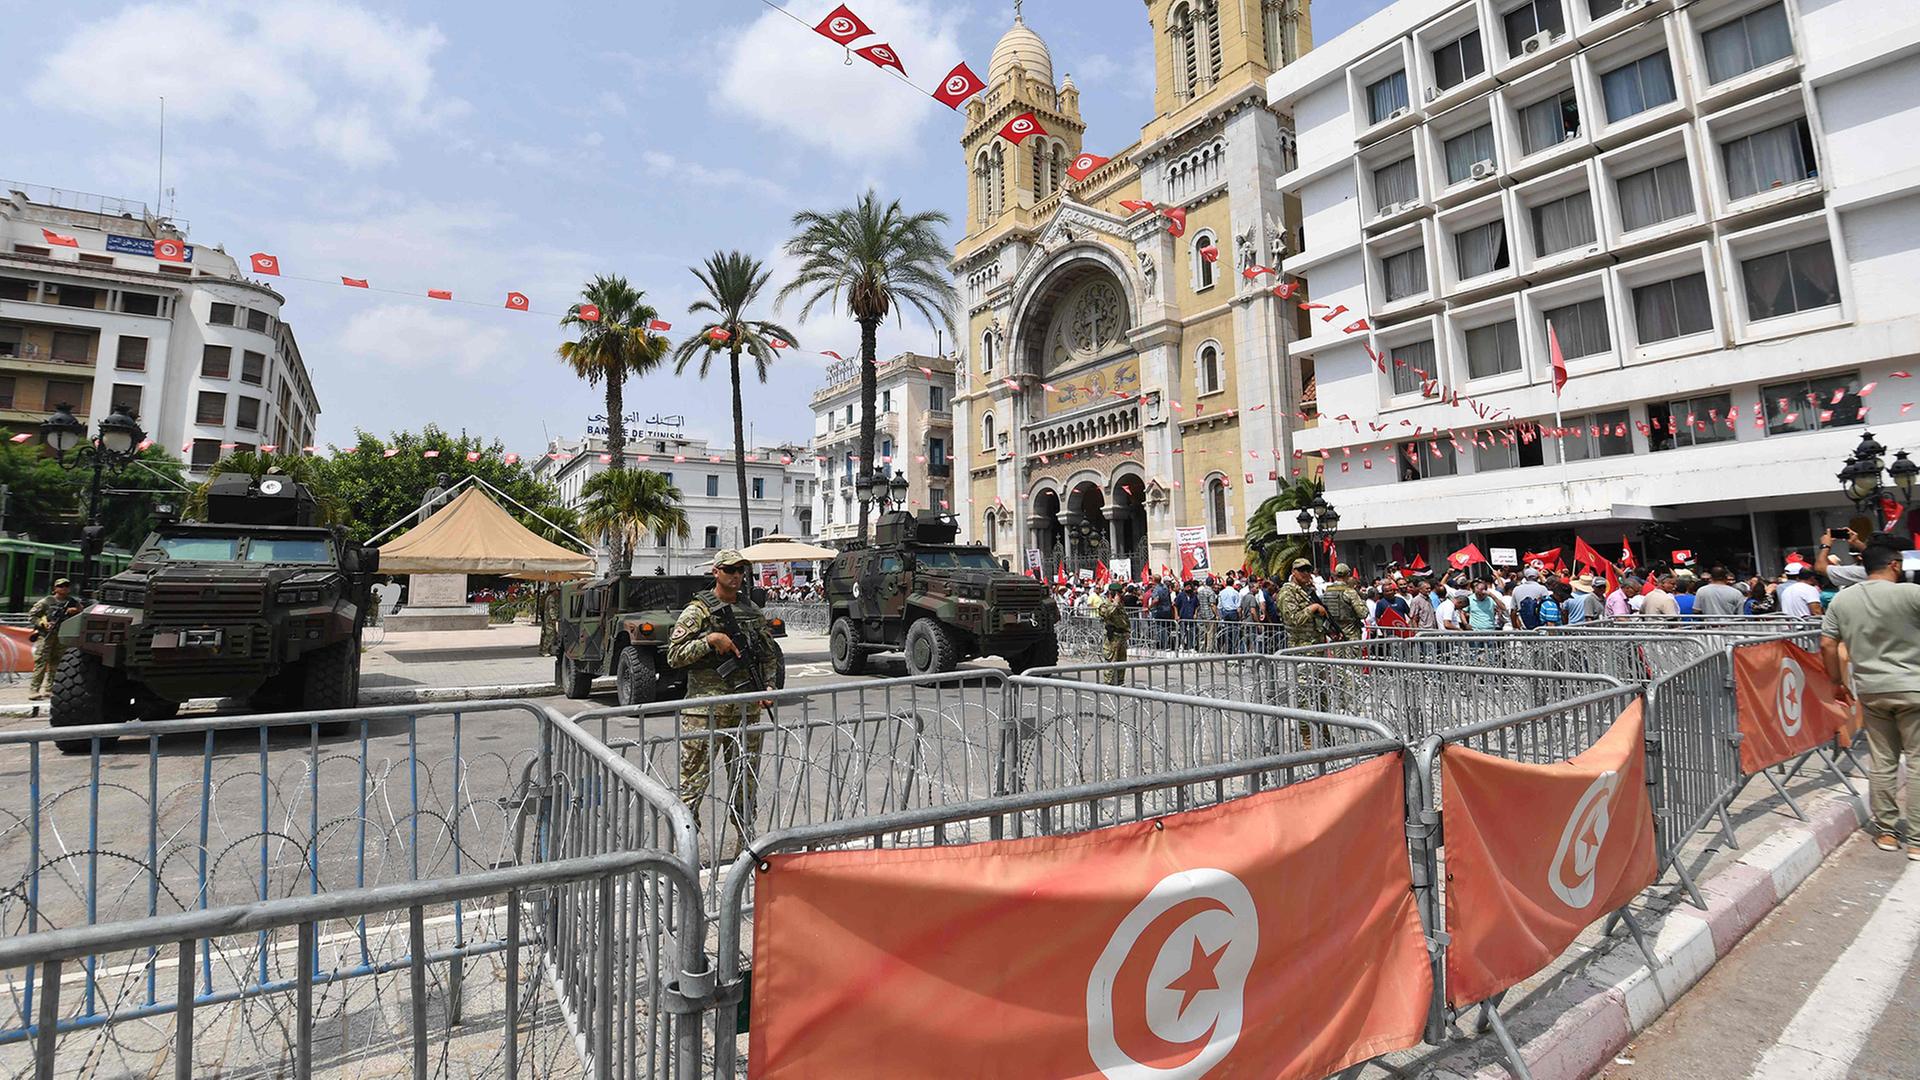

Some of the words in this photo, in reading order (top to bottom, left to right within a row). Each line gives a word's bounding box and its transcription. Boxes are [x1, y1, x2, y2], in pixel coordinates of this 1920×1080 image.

[646, 413, 685, 427] البنك
[587, 425, 628, 437] BANE
[632, 430, 644, 438] DE
[647, 431, 684, 439] TUNISIE
